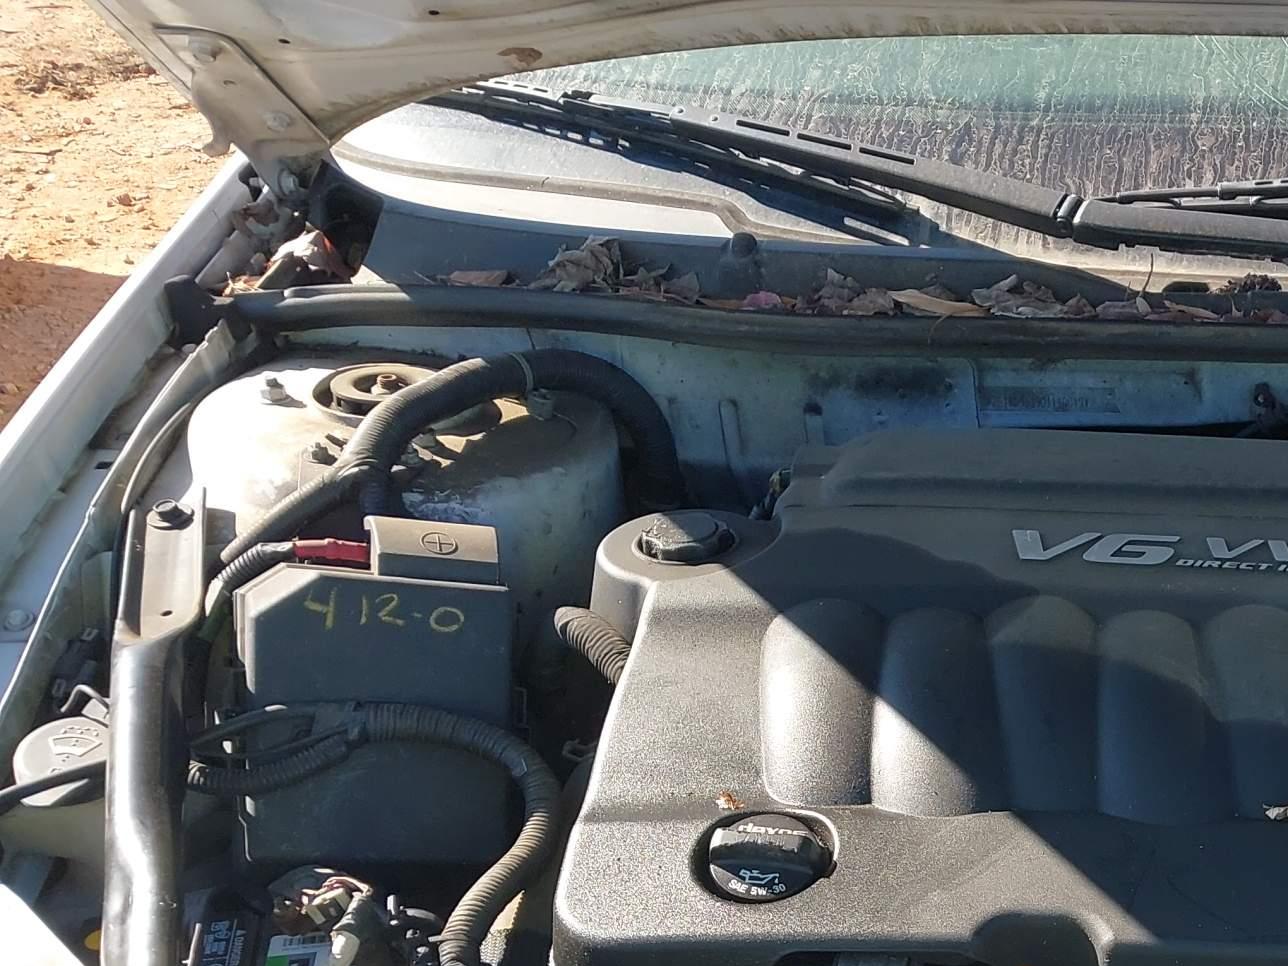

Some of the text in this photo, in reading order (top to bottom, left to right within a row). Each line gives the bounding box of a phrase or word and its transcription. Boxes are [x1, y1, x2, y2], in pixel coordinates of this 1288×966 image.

[1012, 529, 1181, 565] V6
[1175, 558, 1273, 571] DIRECT
[728, 879, 787, 896] SAE 5W-30
